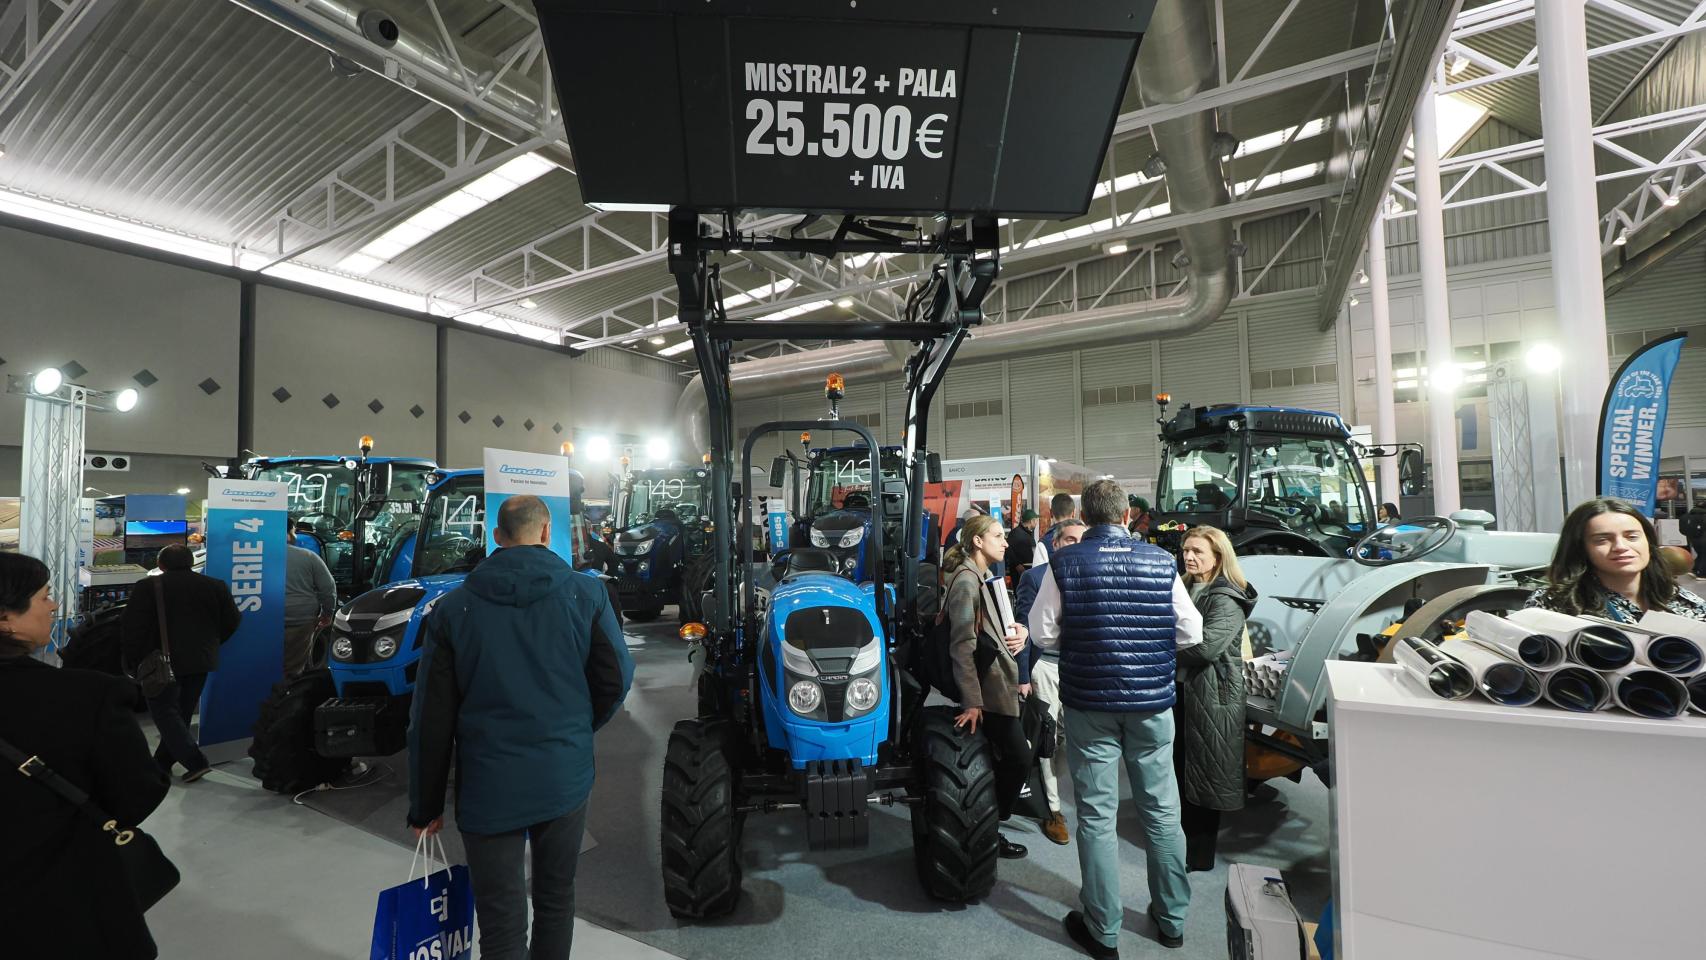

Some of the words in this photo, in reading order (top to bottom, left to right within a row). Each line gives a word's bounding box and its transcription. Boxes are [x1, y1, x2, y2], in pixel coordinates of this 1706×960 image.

[745, 62, 867, 95] MISTRAL2
[874, 74, 890, 93] +
[898, 67, 957, 98] PALA
[850, 170, 864, 186] +
[871, 165, 905, 190] IVA
[1610, 405, 1635, 478] SPECIAL
[1631, 402, 1659, 480] WINNER.
[234, 517, 264, 533] 4
[774, 516, 784, 548] 5-085
[231, 541, 264, 613] SERIE
